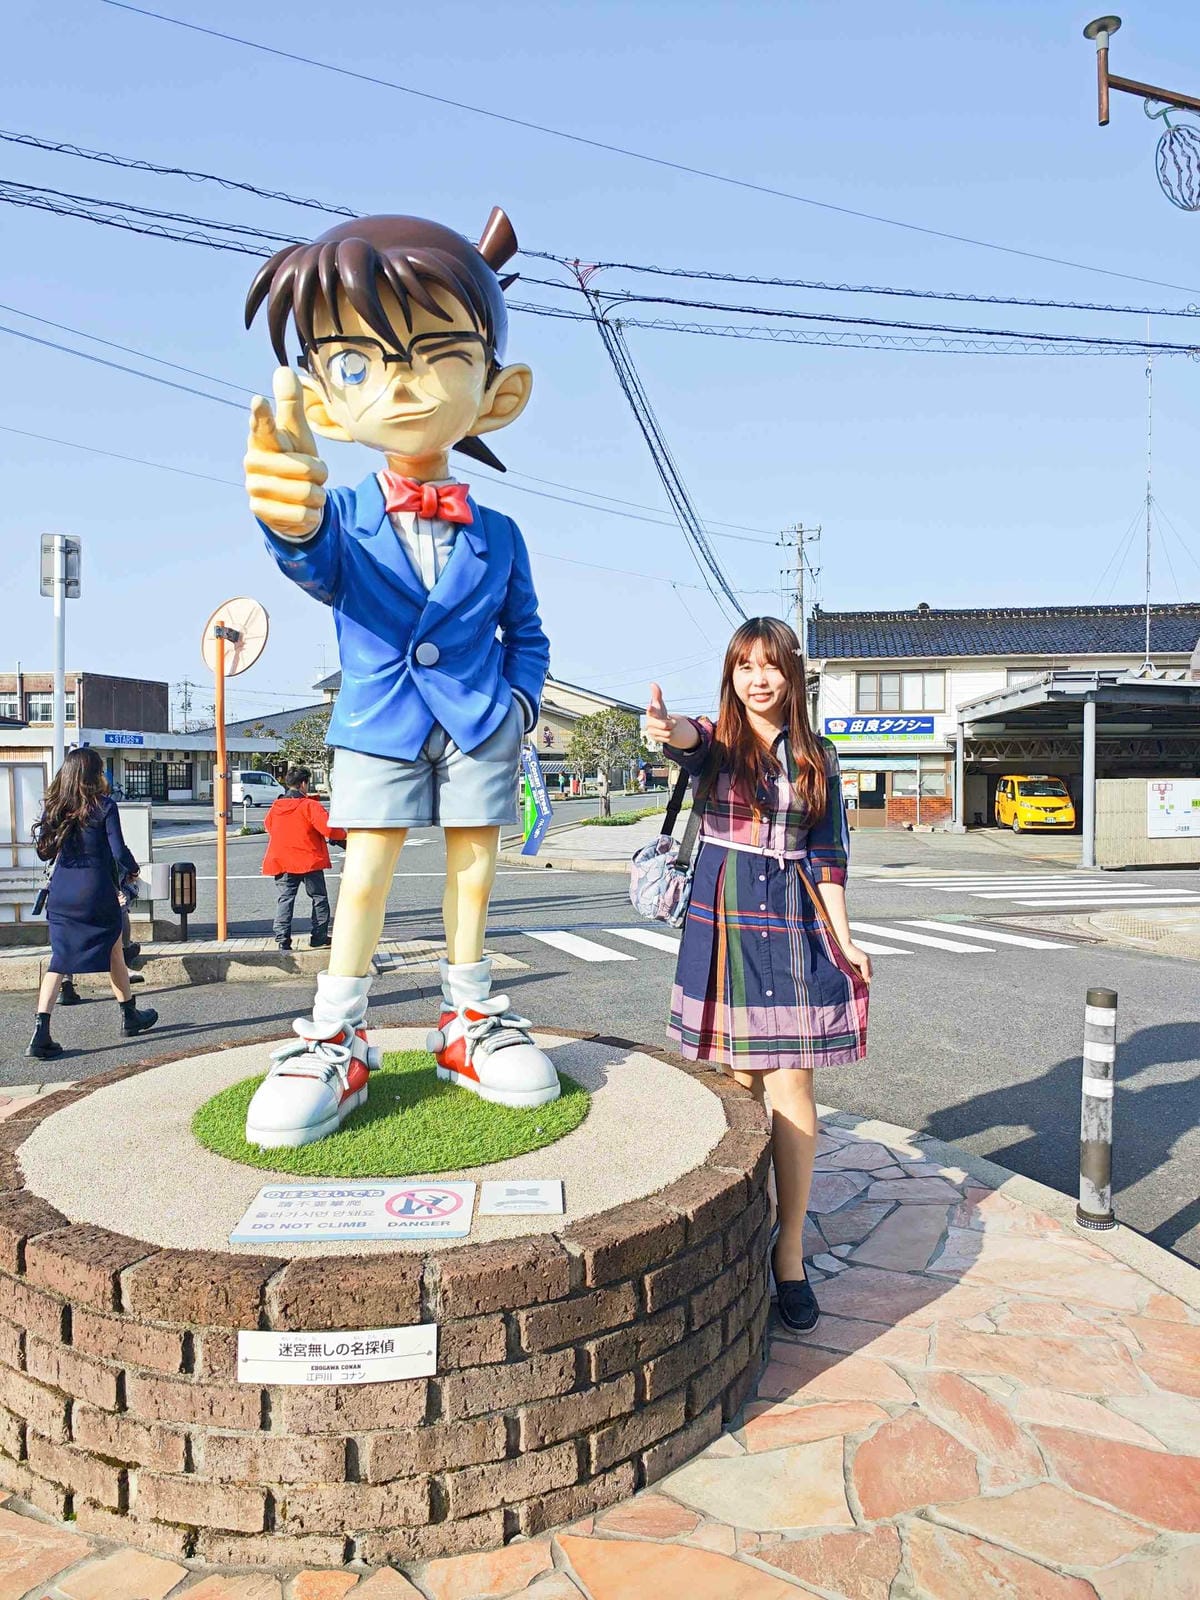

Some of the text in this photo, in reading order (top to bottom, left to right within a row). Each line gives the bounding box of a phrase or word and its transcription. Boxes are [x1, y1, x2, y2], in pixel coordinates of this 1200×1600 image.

[849, 719, 931, 733] 由良タクシー
[530, 760, 541, 788] Conan
[280, 1222, 313, 1230] NOT
[317, 1221, 368, 1229] CLIMB
[387, 1220, 451, 1228] DANGER
[278, 1339, 395, 1358] 迷宮無しの名探偵
[306, 1371, 367, 1381] 江戸川 コナン
